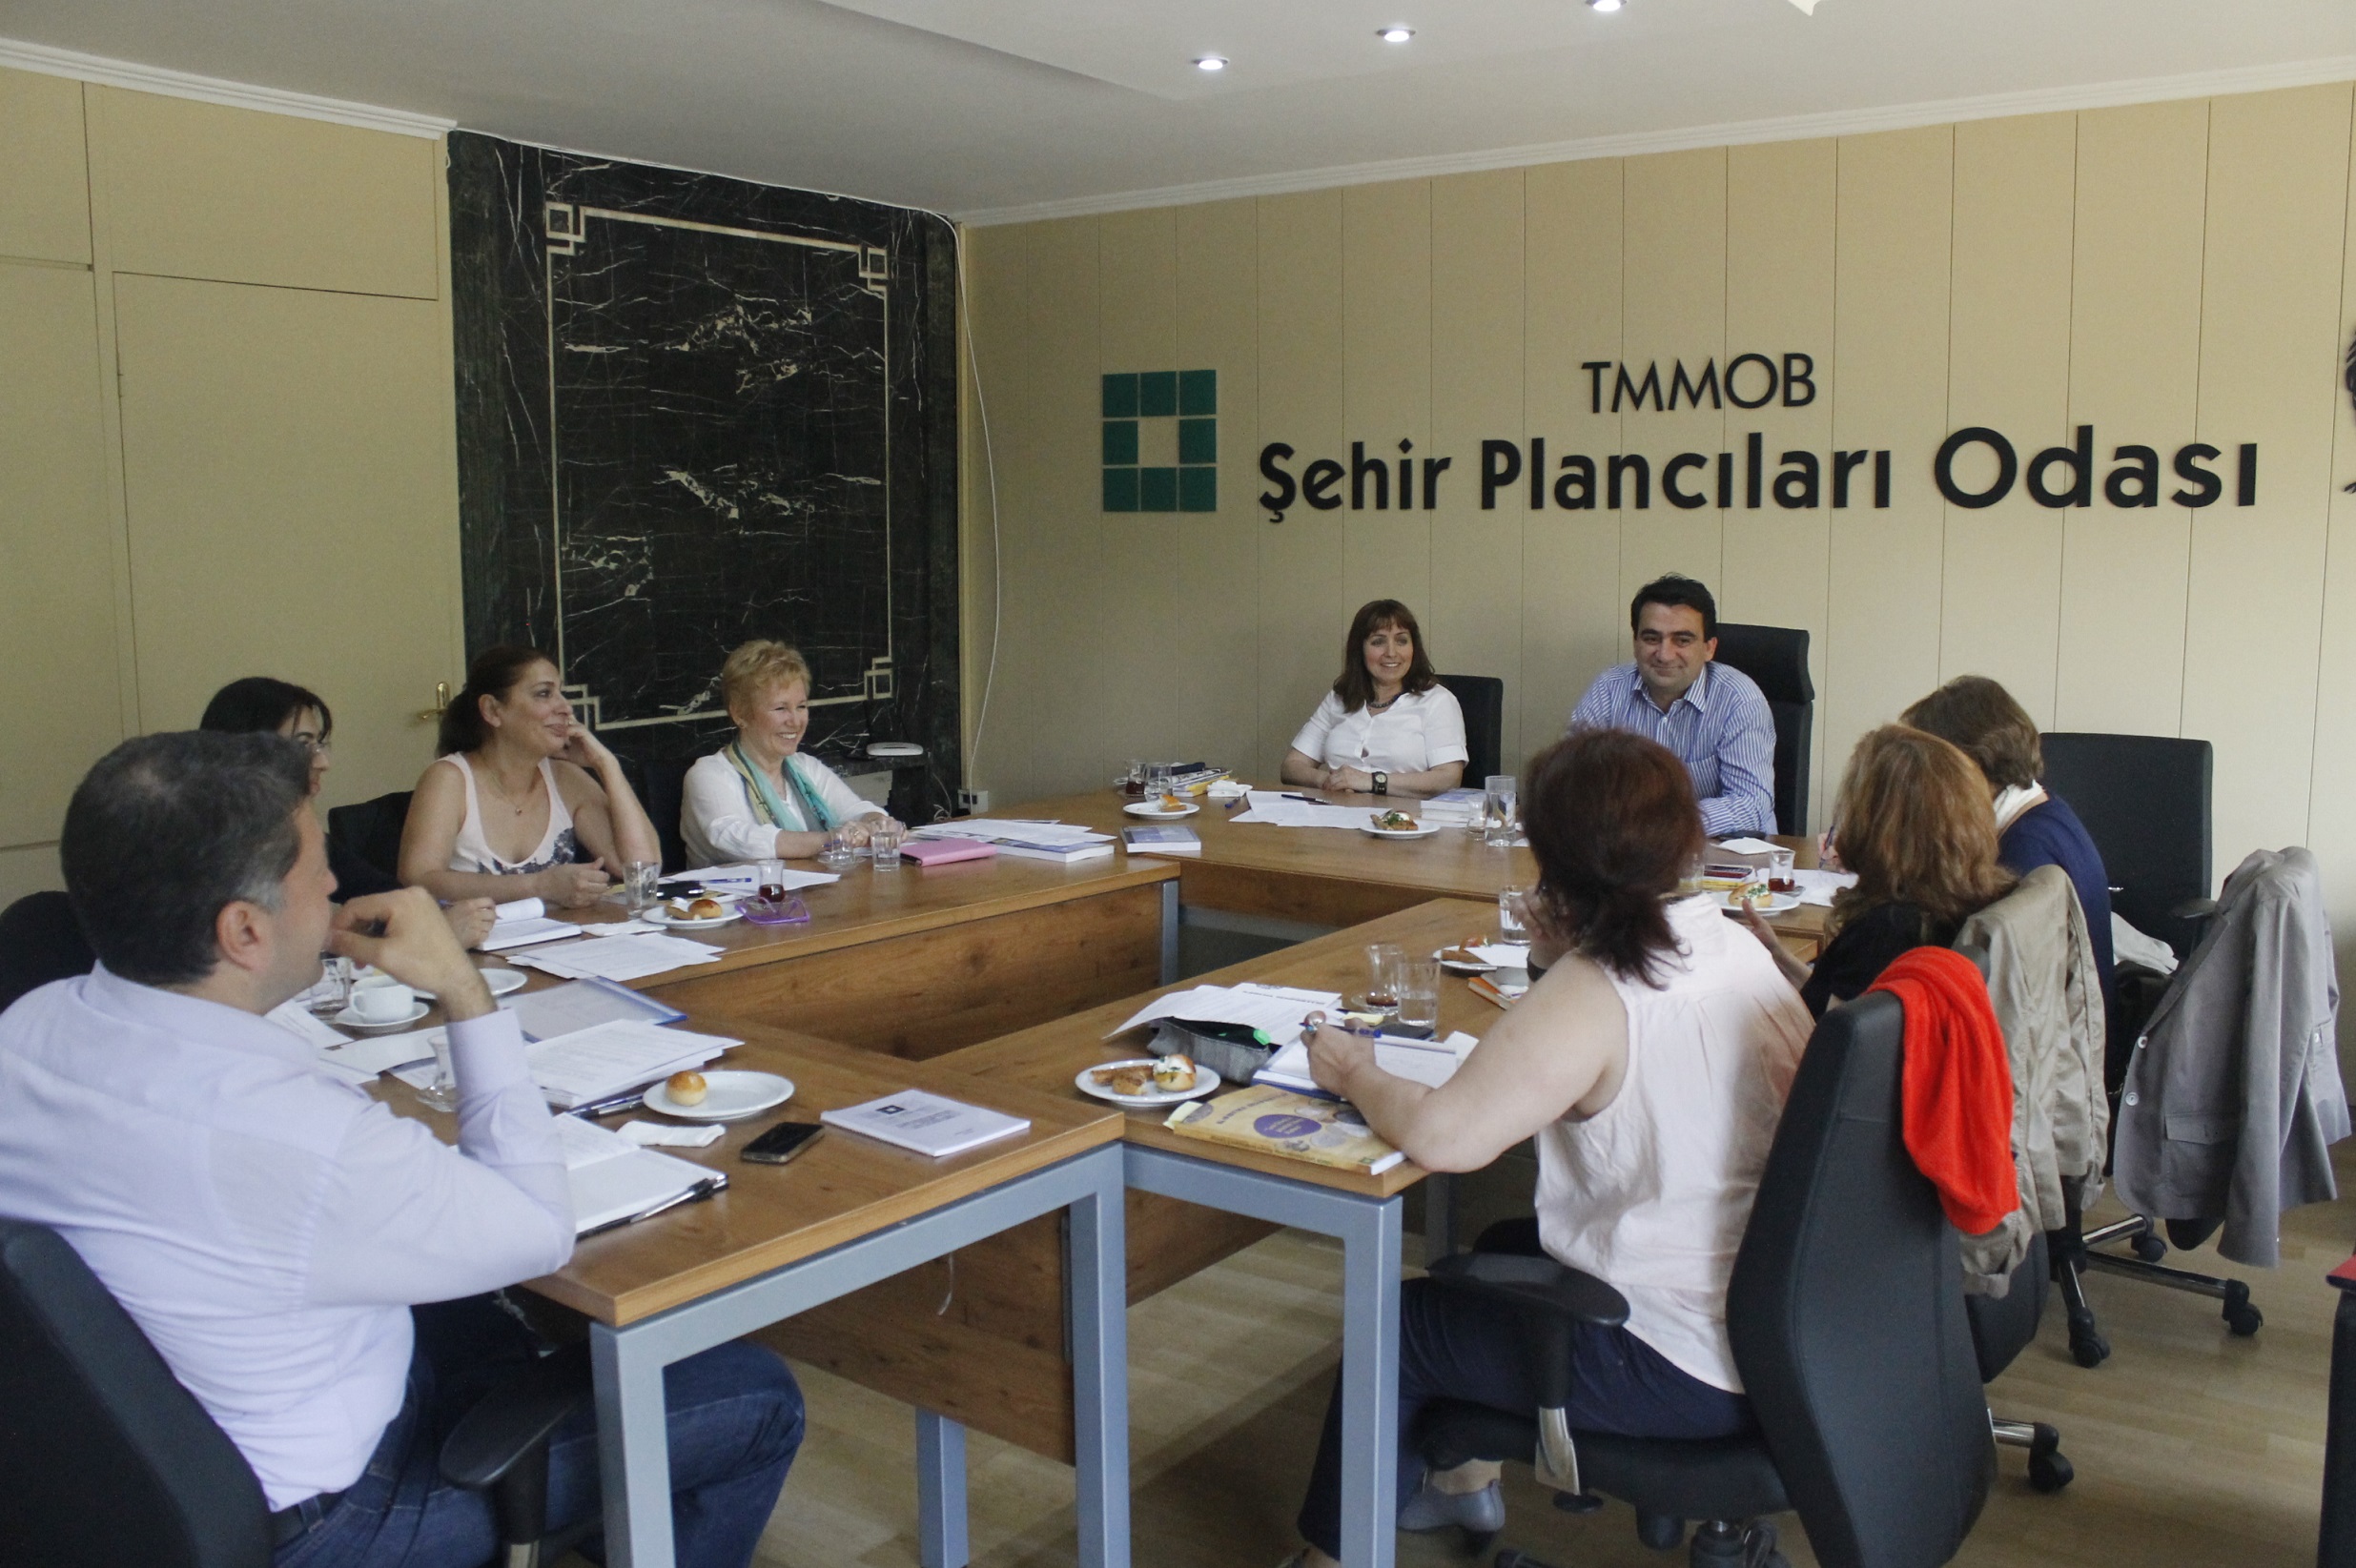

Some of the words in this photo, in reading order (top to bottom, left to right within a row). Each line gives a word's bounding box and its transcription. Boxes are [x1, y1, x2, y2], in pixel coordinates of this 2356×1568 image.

[1581, 354, 1816, 414] TMMOB
[1259, 438, 1451, 524] Şehir
[1481, 432, 1891, 511] Plancıları
[1935, 424, 2258, 509] Odası
